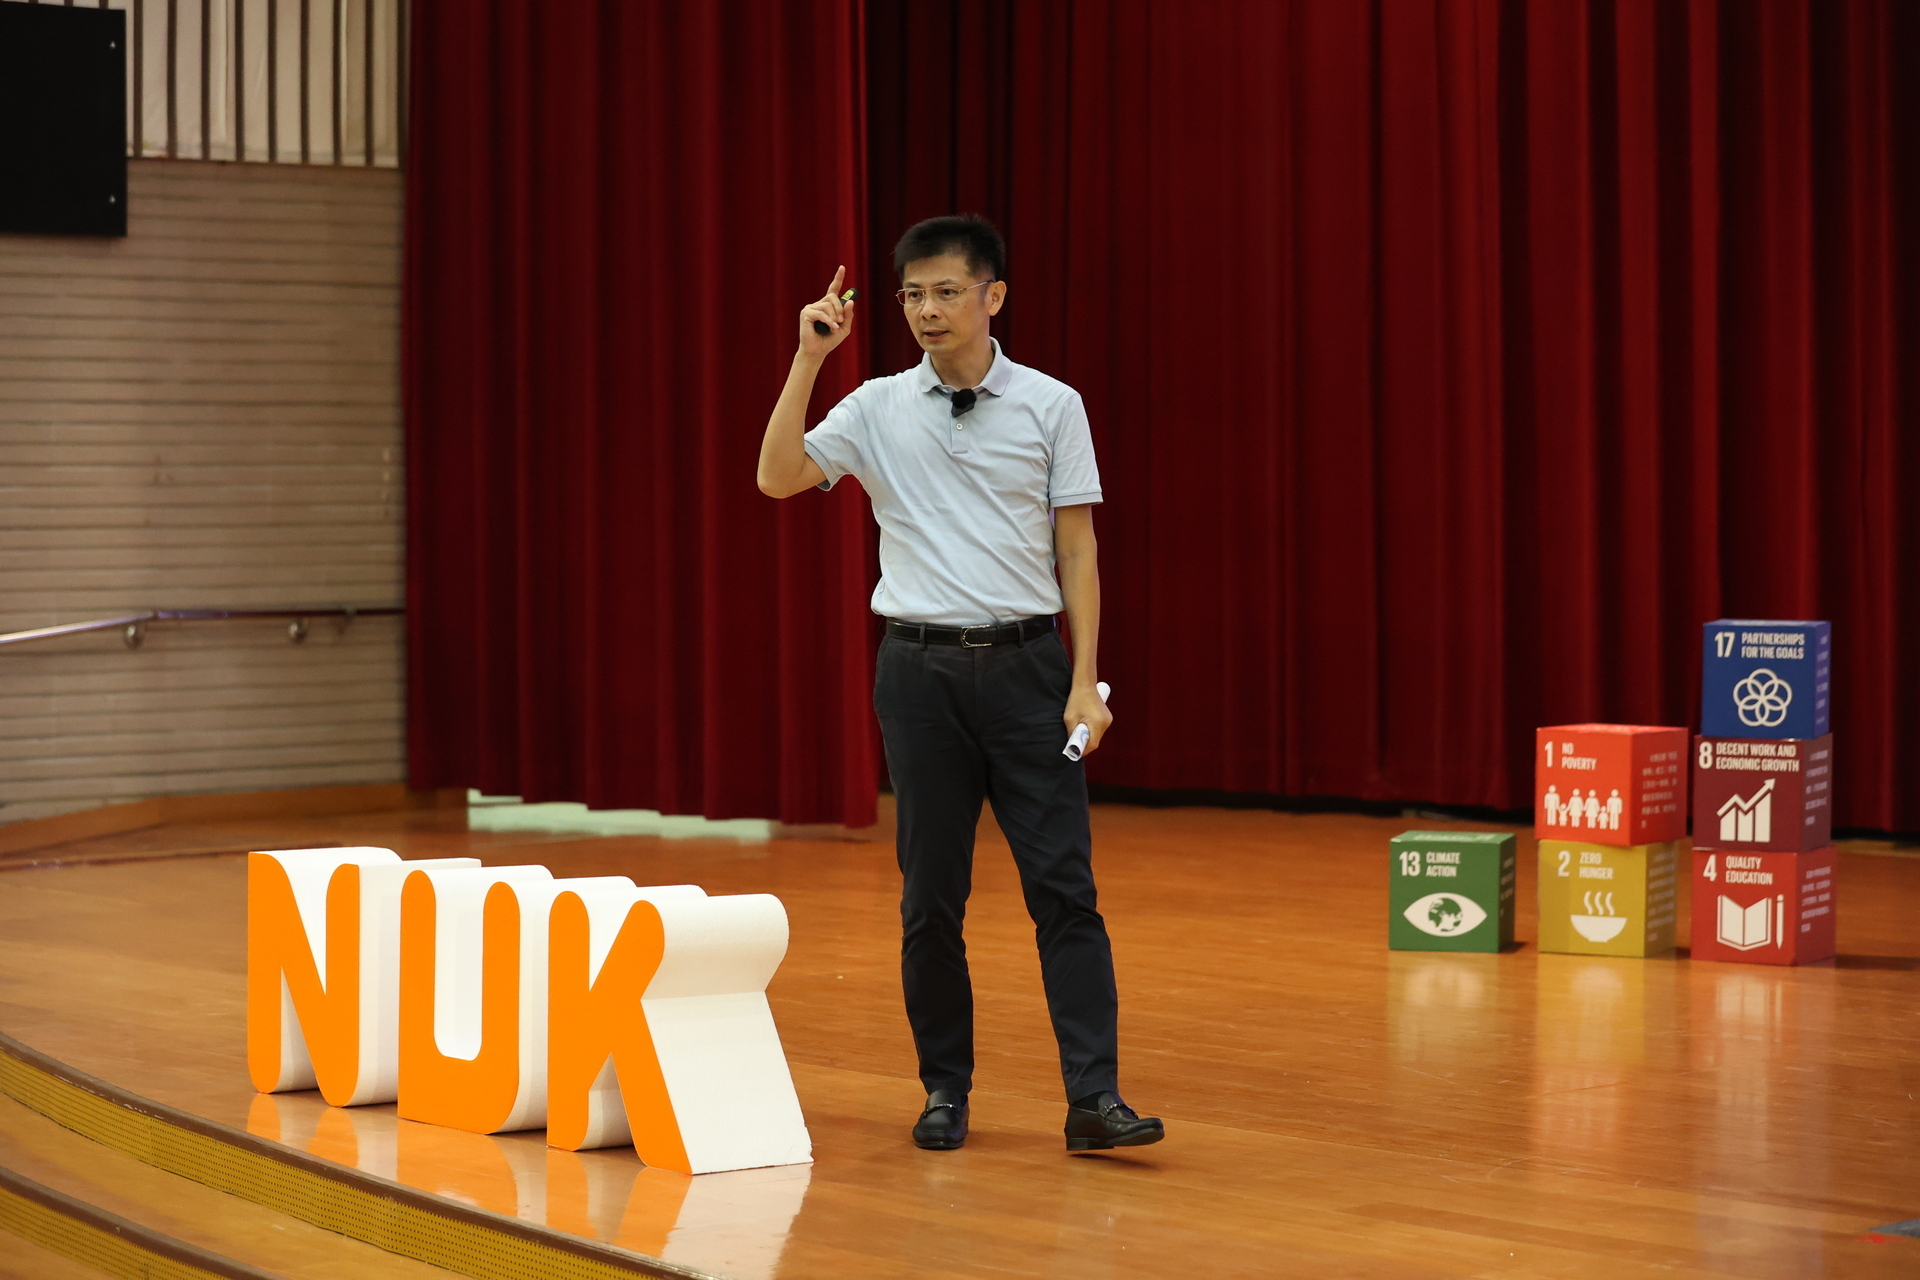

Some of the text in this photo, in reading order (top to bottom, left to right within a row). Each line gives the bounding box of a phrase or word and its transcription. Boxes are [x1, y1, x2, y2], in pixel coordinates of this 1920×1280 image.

[1714, 631, 1736, 658] 17
[1741, 632, 1805, 646] PARTNERSHIPS
[1741, 646, 1805, 660] FOR THE GOALS
[1544, 740, 1554, 768] 1
[1561, 742, 1575, 755] NO
[1698, 741, 1714, 769] 8
[1716, 742, 1797, 758] DECENT WORK AND
[1561, 756, 1597, 771] POVERTY
[1715, 757, 1800, 772] ECONOMIC GROWTH
[1399, 851, 1421, 877] 13
[1425, 851, 1461, 864] CLIMATE
[1557, 850, 1571, 877] 2
[1579, 851, 1603, 865] ZERO
[1725, 855, 1763, 870] QUALITY
[1425, 865, 1457, 878] ACTION
[1578, 866, 1614, 880] HUNGER
[1702, 853, 1718, 882] 4
[1725, 870, 1774, 885] EDUCATION
[248, 850, 693, 1175] NUK
